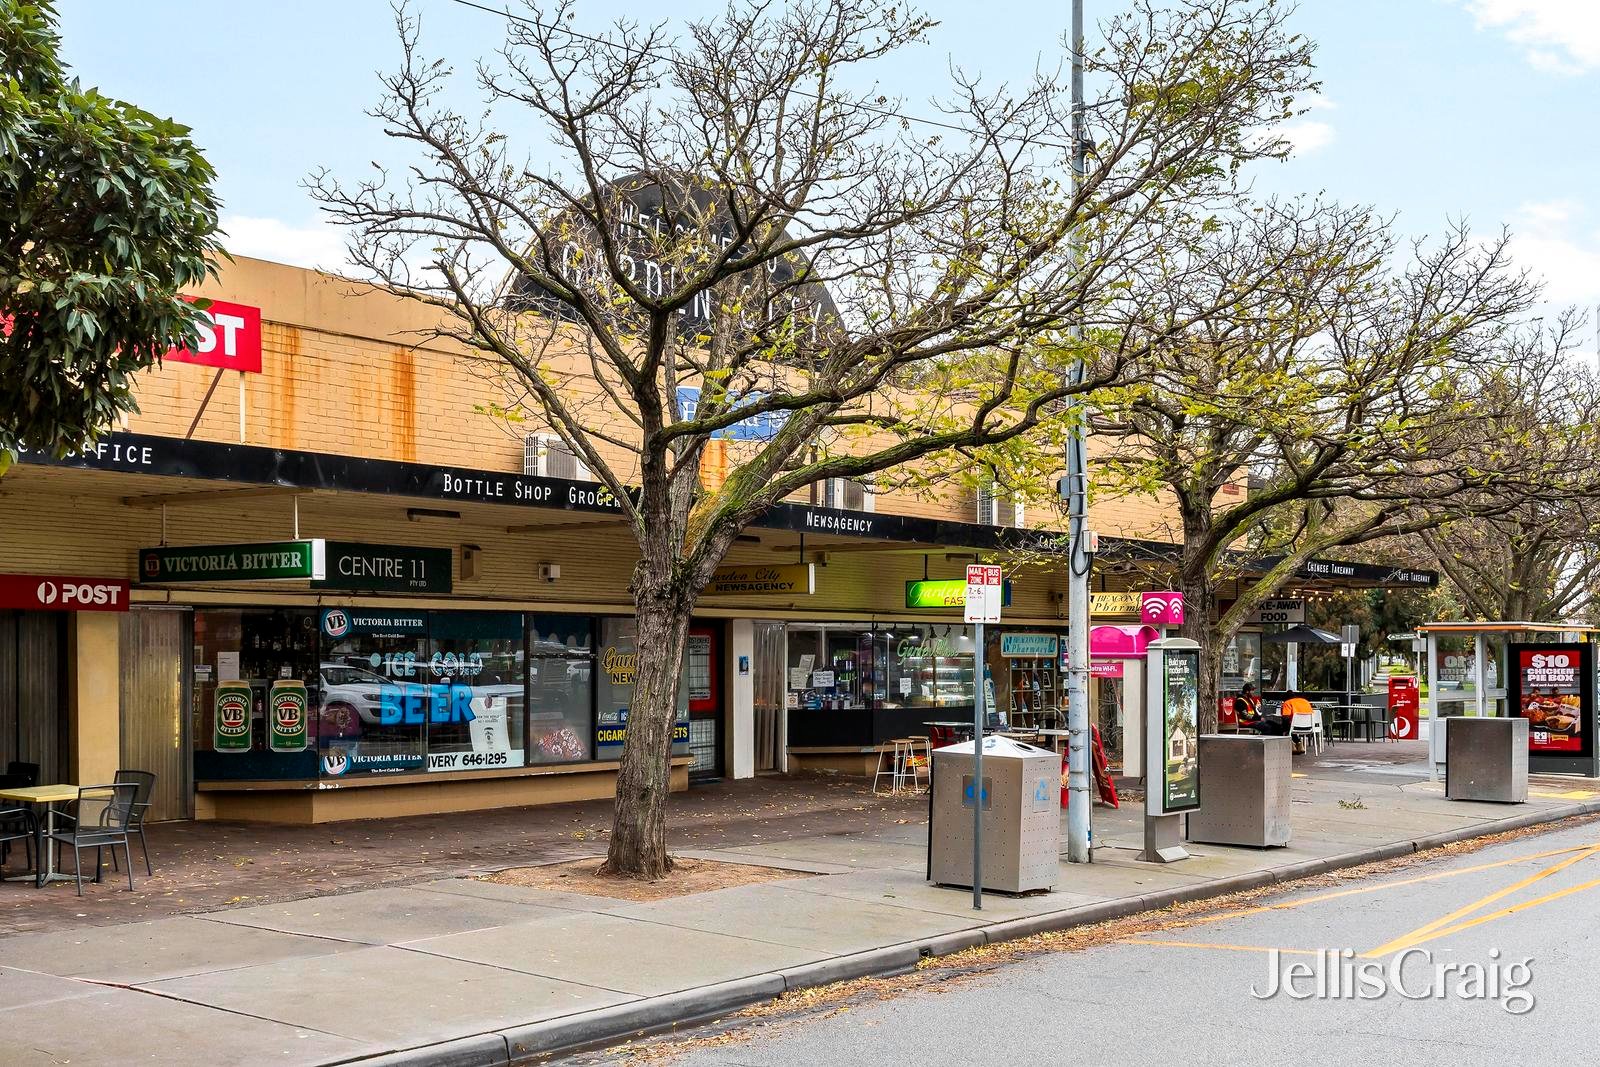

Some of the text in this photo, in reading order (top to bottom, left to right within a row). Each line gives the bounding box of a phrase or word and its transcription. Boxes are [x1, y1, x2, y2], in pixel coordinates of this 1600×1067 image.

[443, 473, 622, 508] BOTTLE SHOP GROCER
[806, 511, 873, 532] NEWSAGENCY
[164, 552, 239, 573] VICTORIA
[242, 551, 302, 571] BITTER
[338, 555, 426, 579] CENTRE 11
[1307, 561, 1355, 576] CHINESE TAKEAWAY
[714, 572, 748, 583] arden
[969, 567, 983, 576] MAIL
[988, 568, 999, 577] BUS
[1410, 572, 1430, 583] TAKEAWAY
[715, 582, 795, 592] NEWSAGENCY
[62, 583, 121, 605] POST
[943, 596, 967, 606] FAS
[1257, 600, 1302, 610] KE-AWAY
[326, 614, 424, 630] VB VICTORIA BITTER
[1260, 612, 1288, 622] FOOD
[384, 651, 416, 677] ICE
[1531, 653, 1570, 669] $10
[218, 695, 248, 708] VICTORIA
[273, 695, 303, 708] VICTORIA
[379, 682, 477, 726] BEER
[222, 708, 244, 721] VB
[277, 708, 299, 721] VB
[220, 724, 246, 734] BITTER
[275, 724, 302, 734] BITTER
